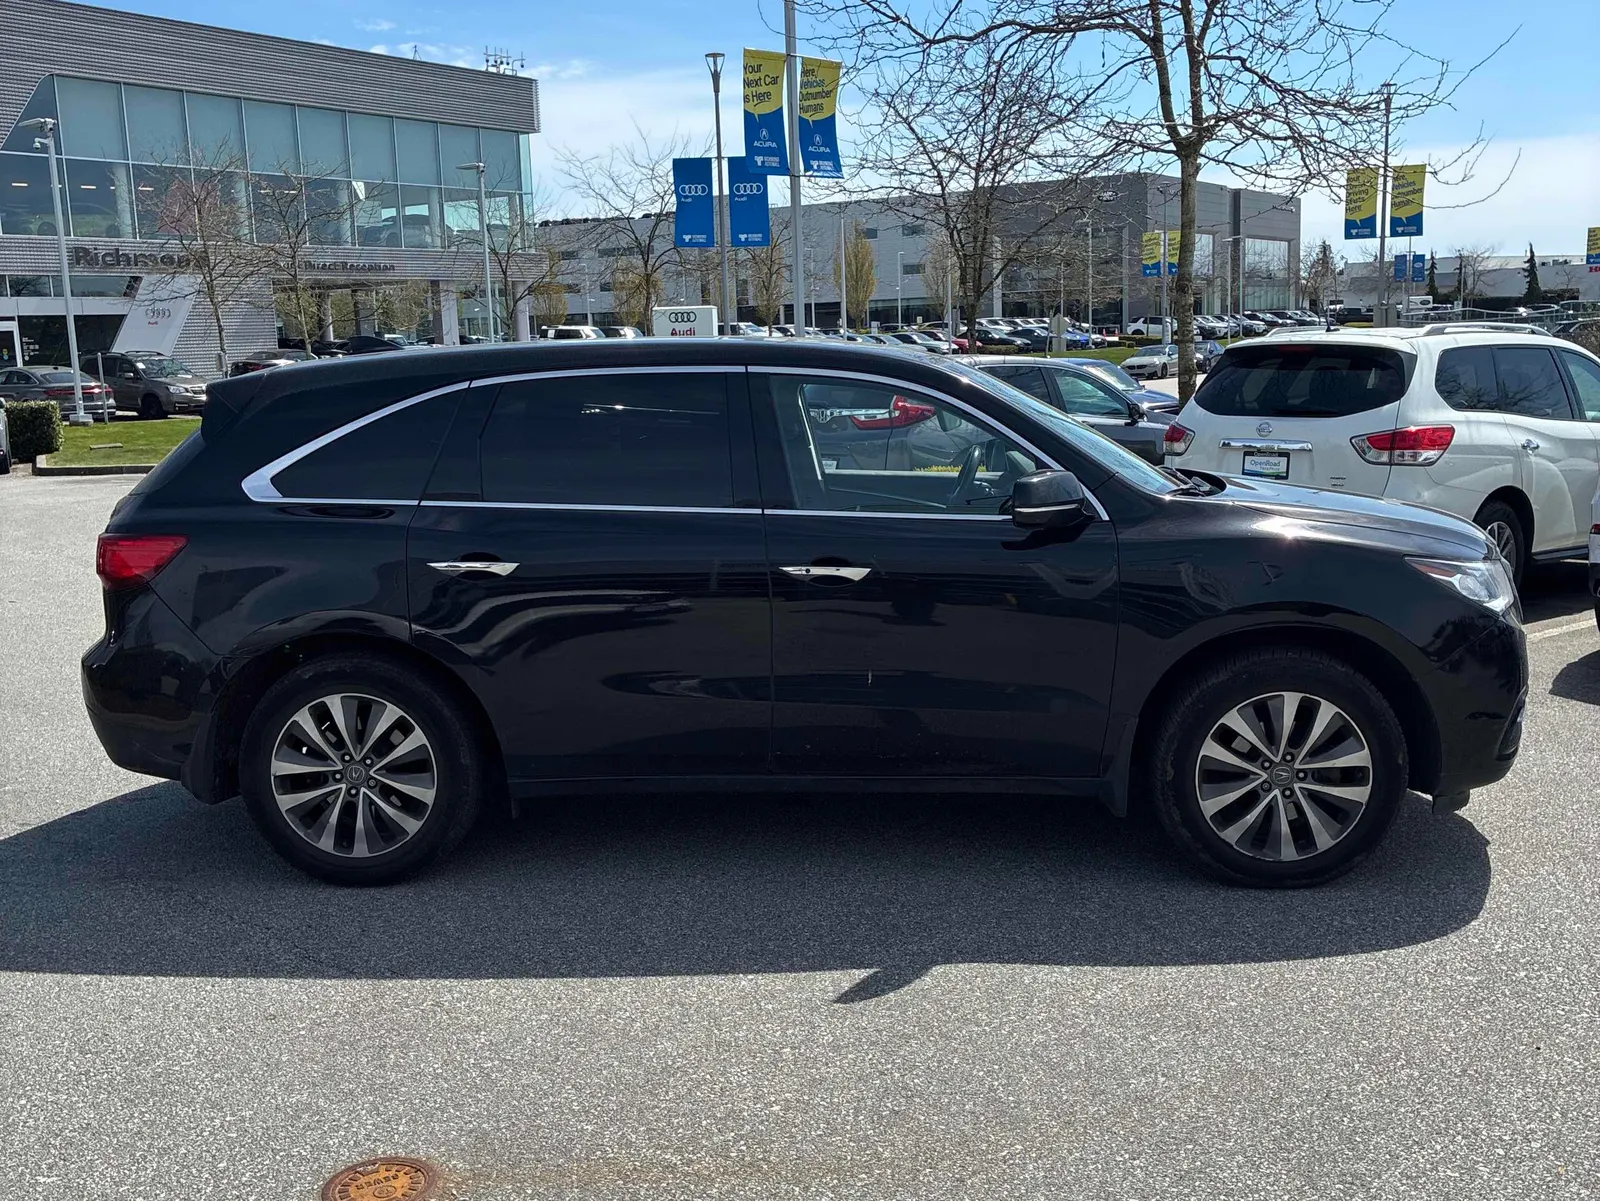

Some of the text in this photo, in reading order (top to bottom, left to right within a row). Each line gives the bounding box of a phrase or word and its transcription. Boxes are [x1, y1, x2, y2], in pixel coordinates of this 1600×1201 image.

[744, 63, 762, 74] Your
[744, 75, 779, 89] Next Car
[752, 91, 771, 102] Here
[799, 88, 832, 102] Outnumber
[799, 102, 824, 114] Humans
[670, 327, 696, 336] Audi
[1250, 459, 1280, 467] OpenRoad
